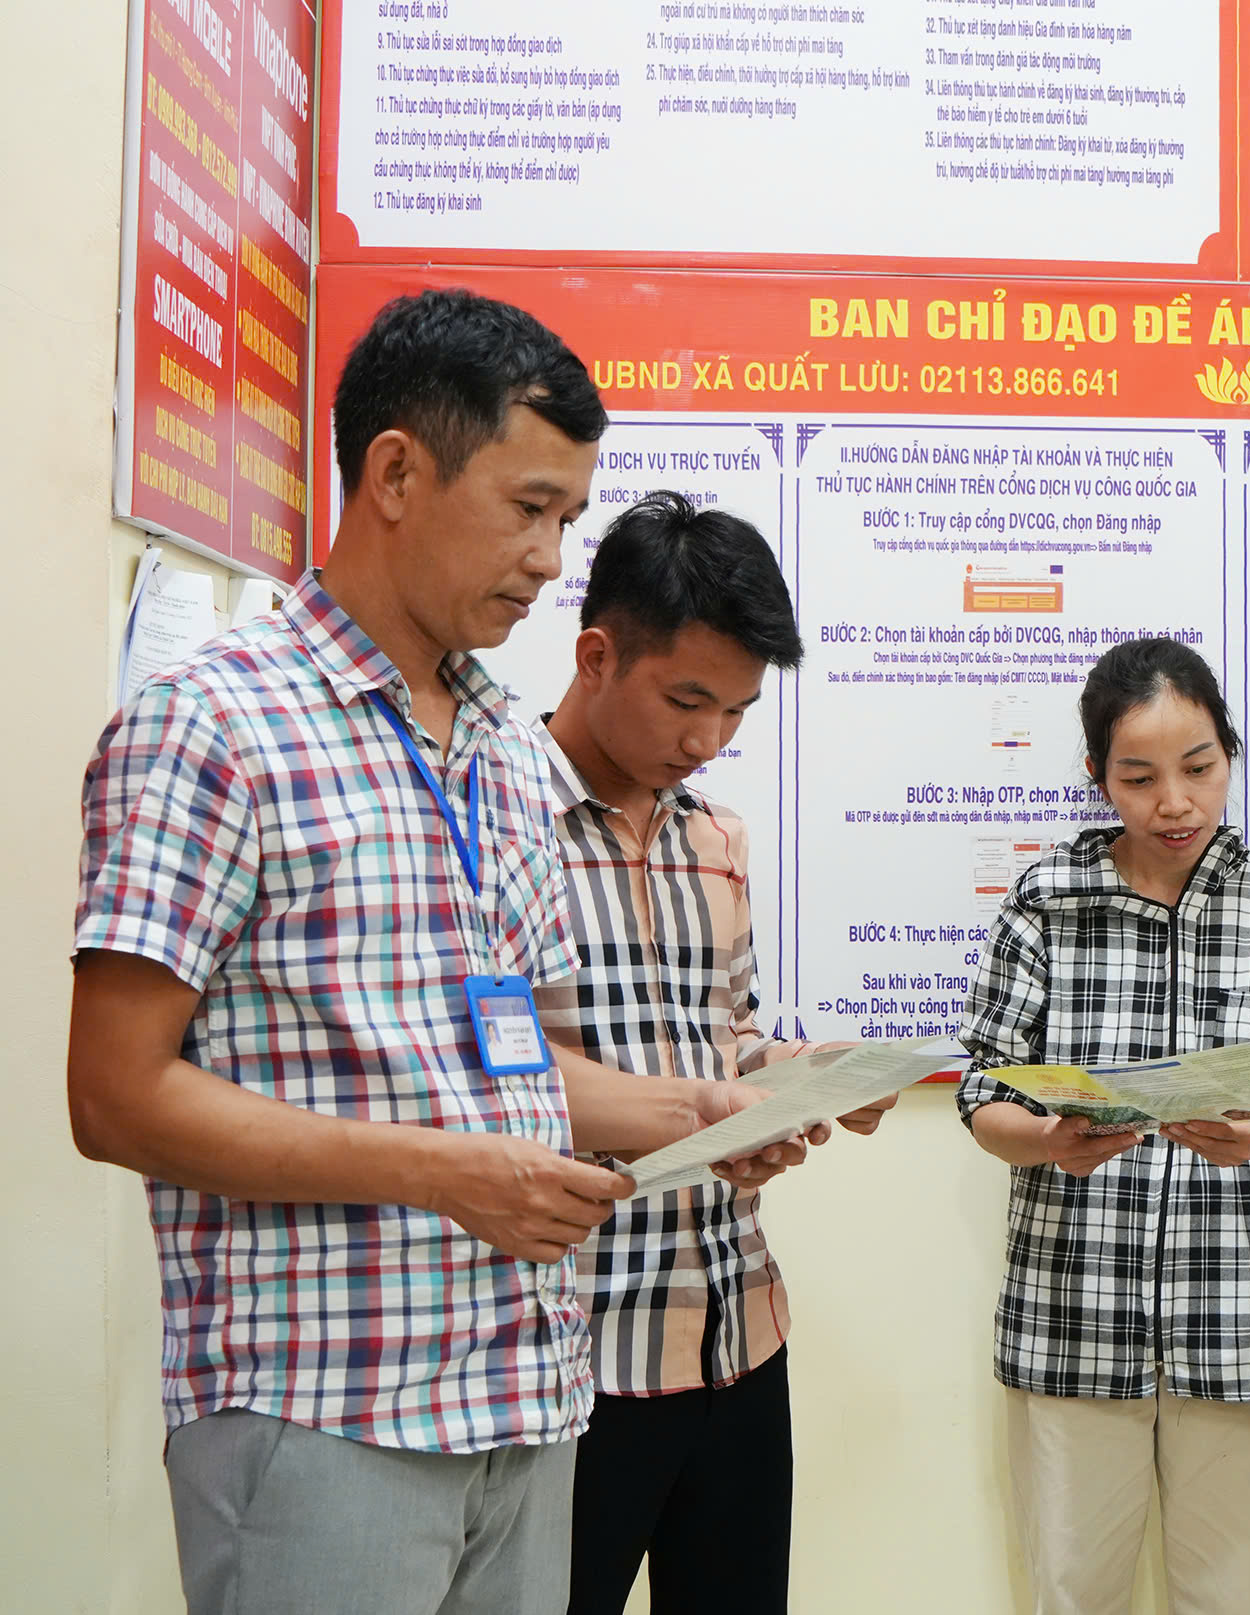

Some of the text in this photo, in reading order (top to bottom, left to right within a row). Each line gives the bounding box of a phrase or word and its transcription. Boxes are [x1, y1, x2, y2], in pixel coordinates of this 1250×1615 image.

[373, 190, 481, 214] 12. Thủ tục đăng ký khai sinh
[153, 273, 223, 369] SMARTPHONE
[809, 298, 908, 337] BAN
[926, 288, 1006, 340] CHỈ
[1021, 302, 1116, 351] ĐẠO
[1132, 293, 1191, 344] ĐỀ
[593, 351, 1119, 397] UBND XÃ QUẤT LƯU: 02113.866.641
[609, 446, 759, 473] DỊCH VỤ TRỰC TUYẾN
[840, 440, 1172, 474] II.HƯỚNG DẪN ĐĂNG NHẬP TÀI KHOẢN VÀ THỰC HIỆN
[599, 488, 629, 503] BƯỚC
[705, 490, 718, 504] tin
[815, 473, 1196, 499] THỦ TỤC HÀNH CHÍNH TRÊN CỔNG DỊCH VỤ CÔNG QUỐC GIA
[863, 506, 1161, 534] BƯỚC 1: Truy cập cổng DVCQG, chọn Đăng nhập
[821, 621, 856, 642] BƯỚC
[860, 626, 871, 642] 2:
[875, 625, 906, 646] Chọn
[910, 625, 925, 642] tài
[929, 624, 964, 642] khoản
[968, 624, 990, 647] cấp
[993, 624, 1012, 643] bởi
[1016, 626, 1064, 646] DVCQG,
[1068, 626, 1097, 647] nhập
[906, 781, 1086, 807] BƯỚC 3: Nhập OTP, chọn Xác
[849, 920, 987, 945] BƯỚC 4: Thực hiện các
[862, 972, 967, 993] Sau khi vào Trang
[835, 997, 868, 1018] Chọn
[871, 997, 898, 1018] Dịch
[900, 1001, 916, 1017] vụ
[918, 997, 949, 1018] công
[860, 1018, 881, 1038] cần
[885, 1021, 912, 1040] thực
